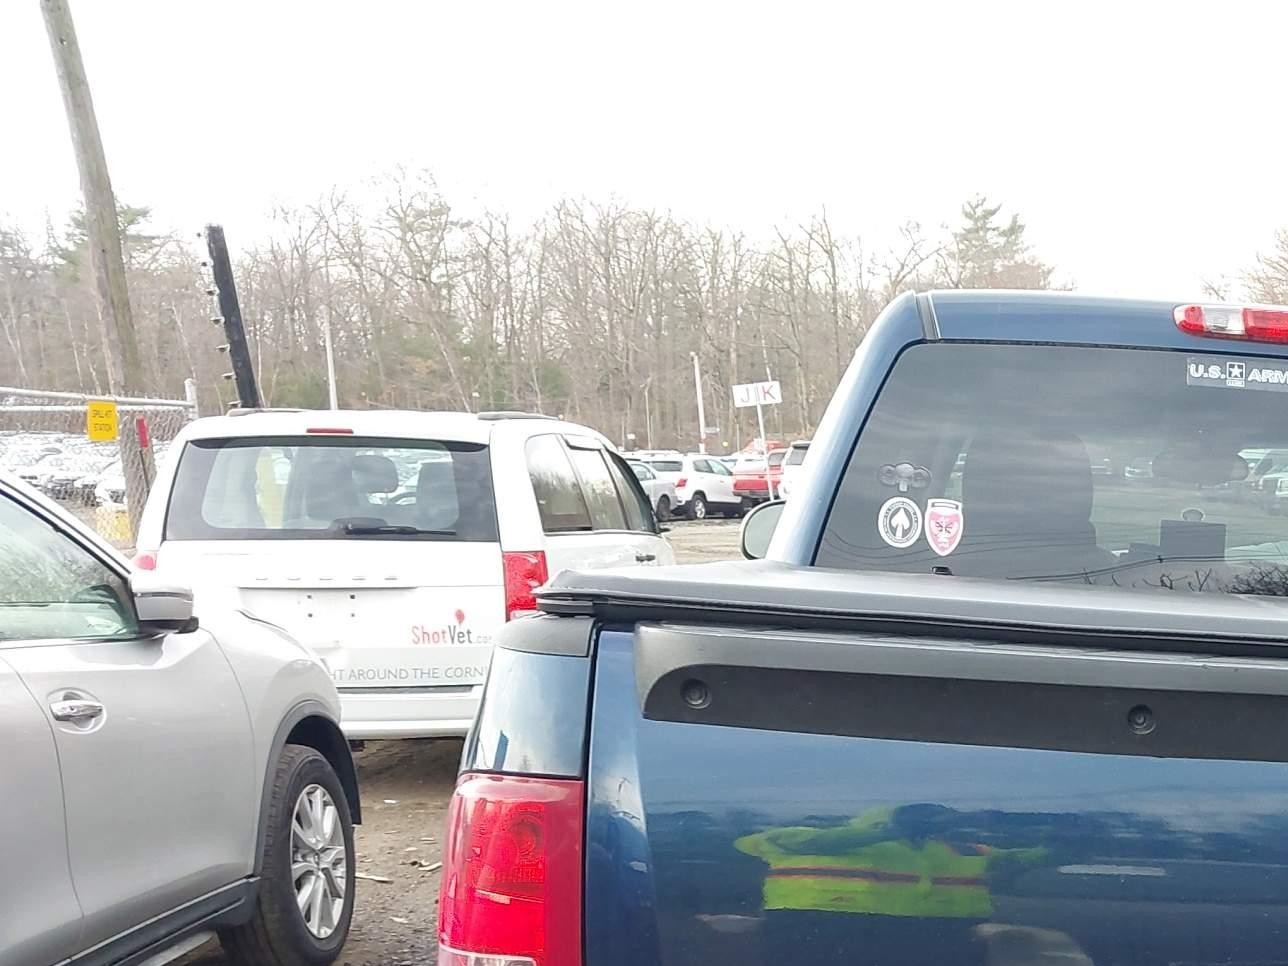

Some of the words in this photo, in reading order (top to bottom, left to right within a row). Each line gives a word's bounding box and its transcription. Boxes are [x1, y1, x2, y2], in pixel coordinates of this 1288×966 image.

[1189, 363, 1227, 380] U.S.
[761, 384, 777, 401] K
[349, 668, 409, 681] AROUND
[412, 667, 441, 679] THE
[444, 666, 488, 679] CORN
